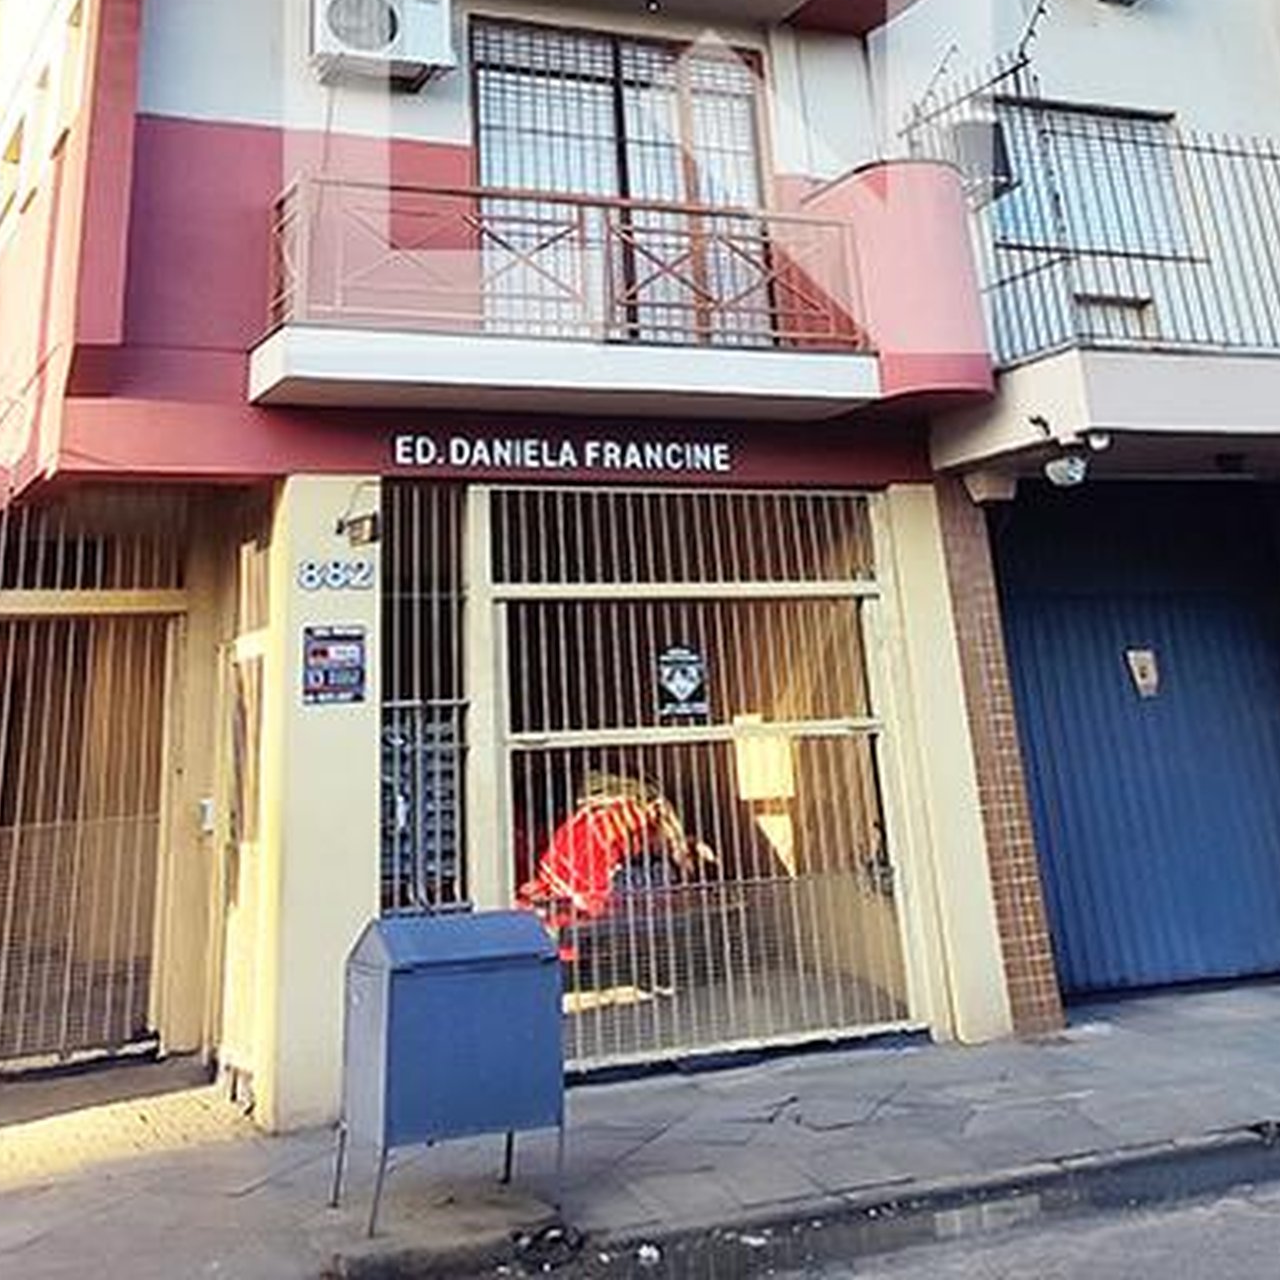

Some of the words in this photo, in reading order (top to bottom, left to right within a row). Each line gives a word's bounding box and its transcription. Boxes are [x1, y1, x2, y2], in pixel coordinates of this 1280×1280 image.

[395, 436, 444, 465] ED.
[450, 437, 576, 467] DANIELA
[585, 441, 730, 470] FRANCINE
[298, 561, 373, 590] 882
